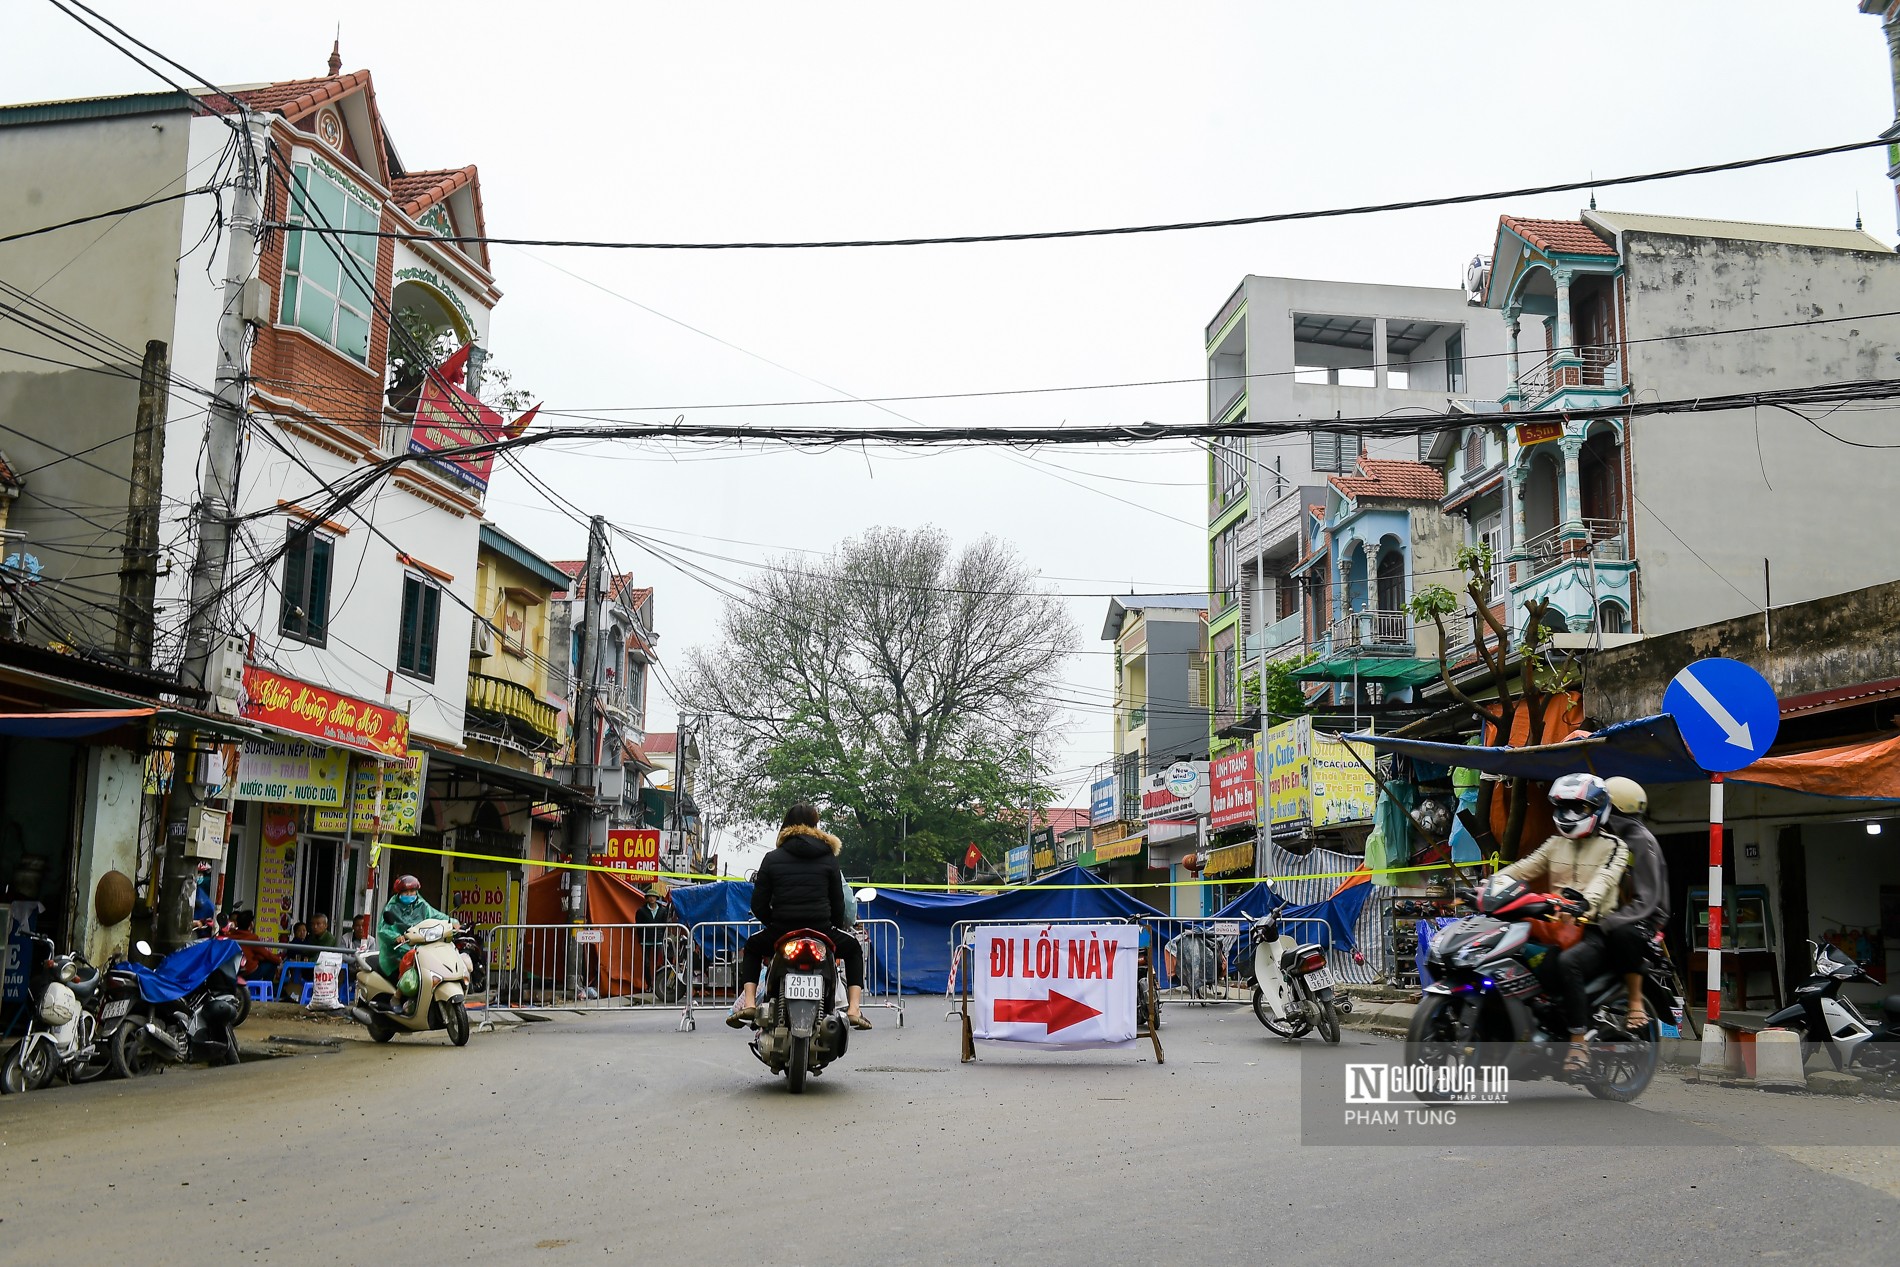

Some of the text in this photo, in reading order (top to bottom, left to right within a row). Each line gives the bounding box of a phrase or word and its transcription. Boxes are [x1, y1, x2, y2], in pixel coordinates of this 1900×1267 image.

[259, 678, 383, 738] Chúc Mừng Năm Mới
[1276, 744, 1295, 767] Cute
[239, 779, 263, 796] NƯỚC
[264, 784, 288, 800] NGỌT
[294, 783, 319, 800] NƯỚC
[623, 834, 656, 858] CÁO
[1746, 847, 1757, 857] 176
[636, 861, 656, 871] CNC
[484, 885, 504, 905] BÒ
[990, 926, 1118, 980] ĐI LỐI NÀY
[791, 976, 817, 987] 29-Y1
[788, 987, 820, 998] 100.69
